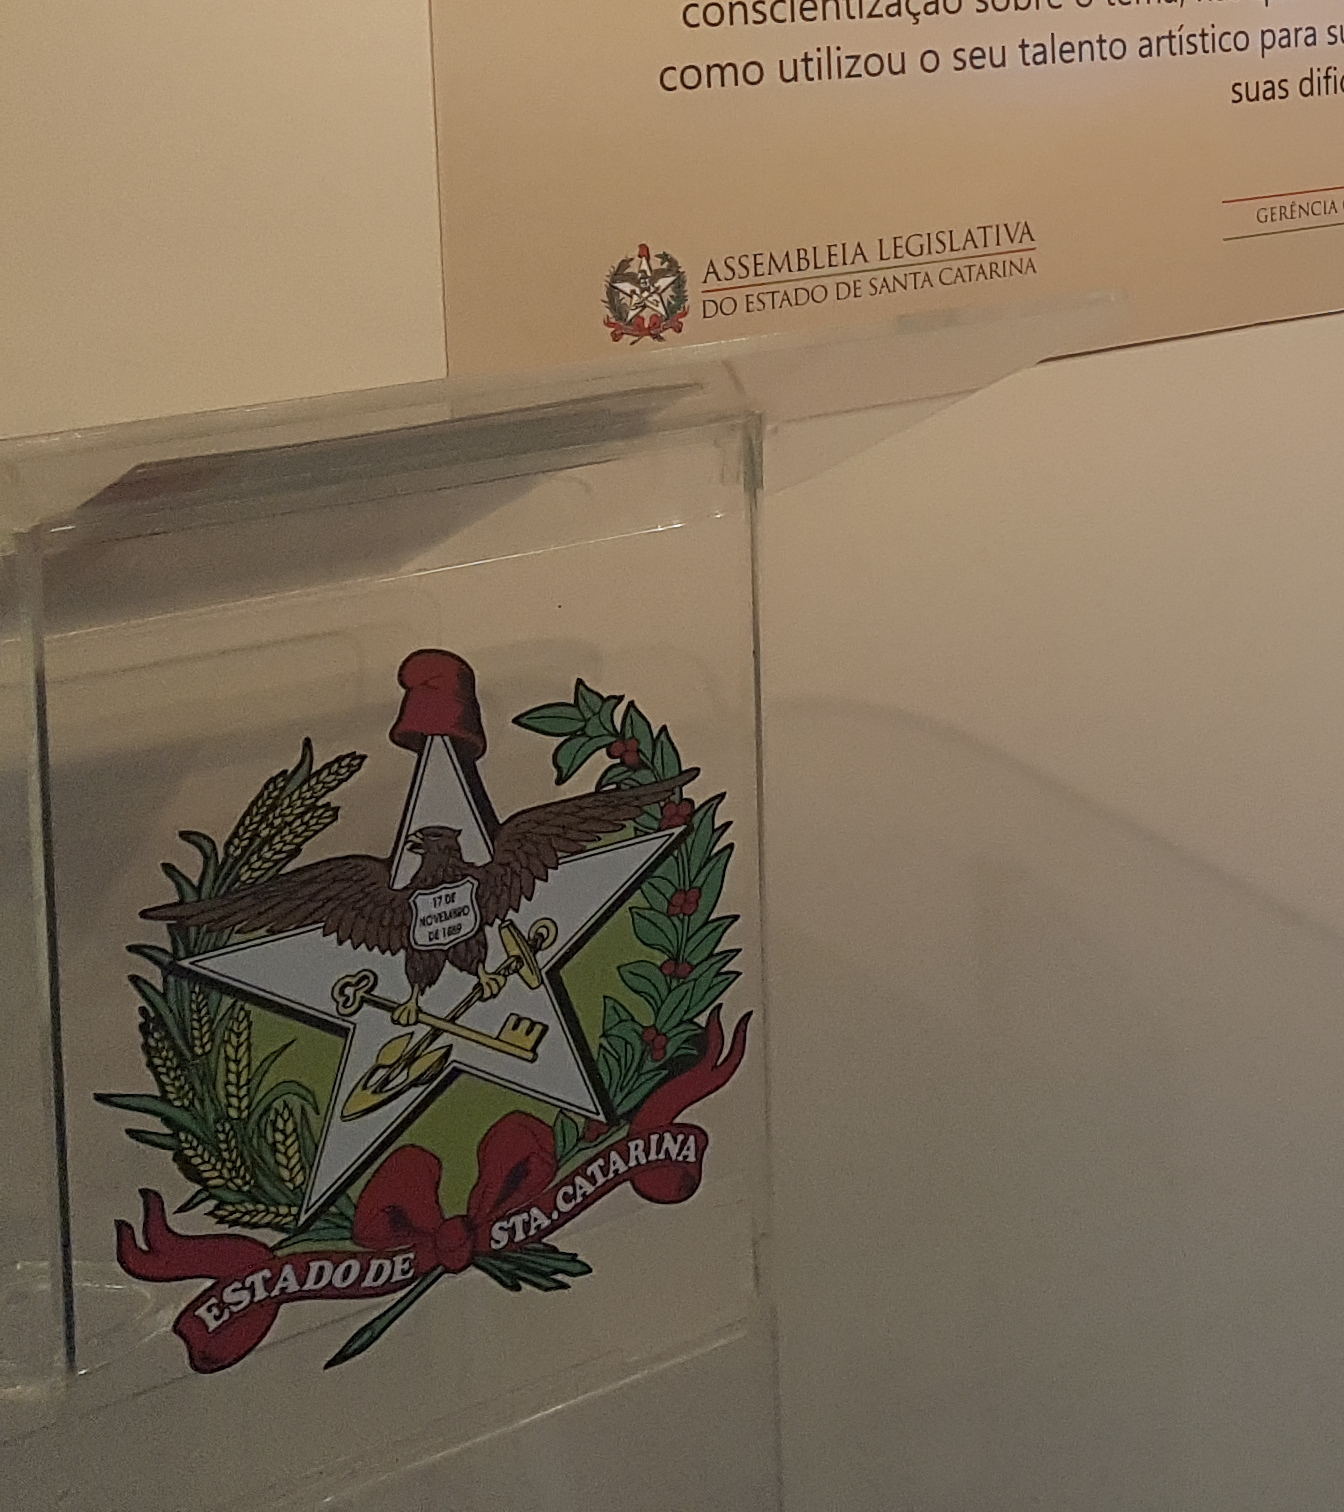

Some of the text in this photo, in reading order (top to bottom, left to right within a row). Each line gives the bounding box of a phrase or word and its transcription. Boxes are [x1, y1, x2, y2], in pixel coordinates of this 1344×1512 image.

[658, 59, 765, 93] como
[777, 44, 907, 84] utilizou
[951, 44, 1007, 72] seu
[1016, 31, 1128, 67] talento
[1137, 22, 1251, 60] artístico
[1259, 24, 1318, 60] para
[1230, 77, 1290, 105] suas
[1256, 201, 1338, 224] GERÊNCIA
[701, 220, 1036, 284] ASSEMBLEIA LEGISLATIVA
[702, 257, 1038, 319] DO ESTADO DE SANTA CATARINA
[194, 1252, 416, 1334] ESTADO DE
